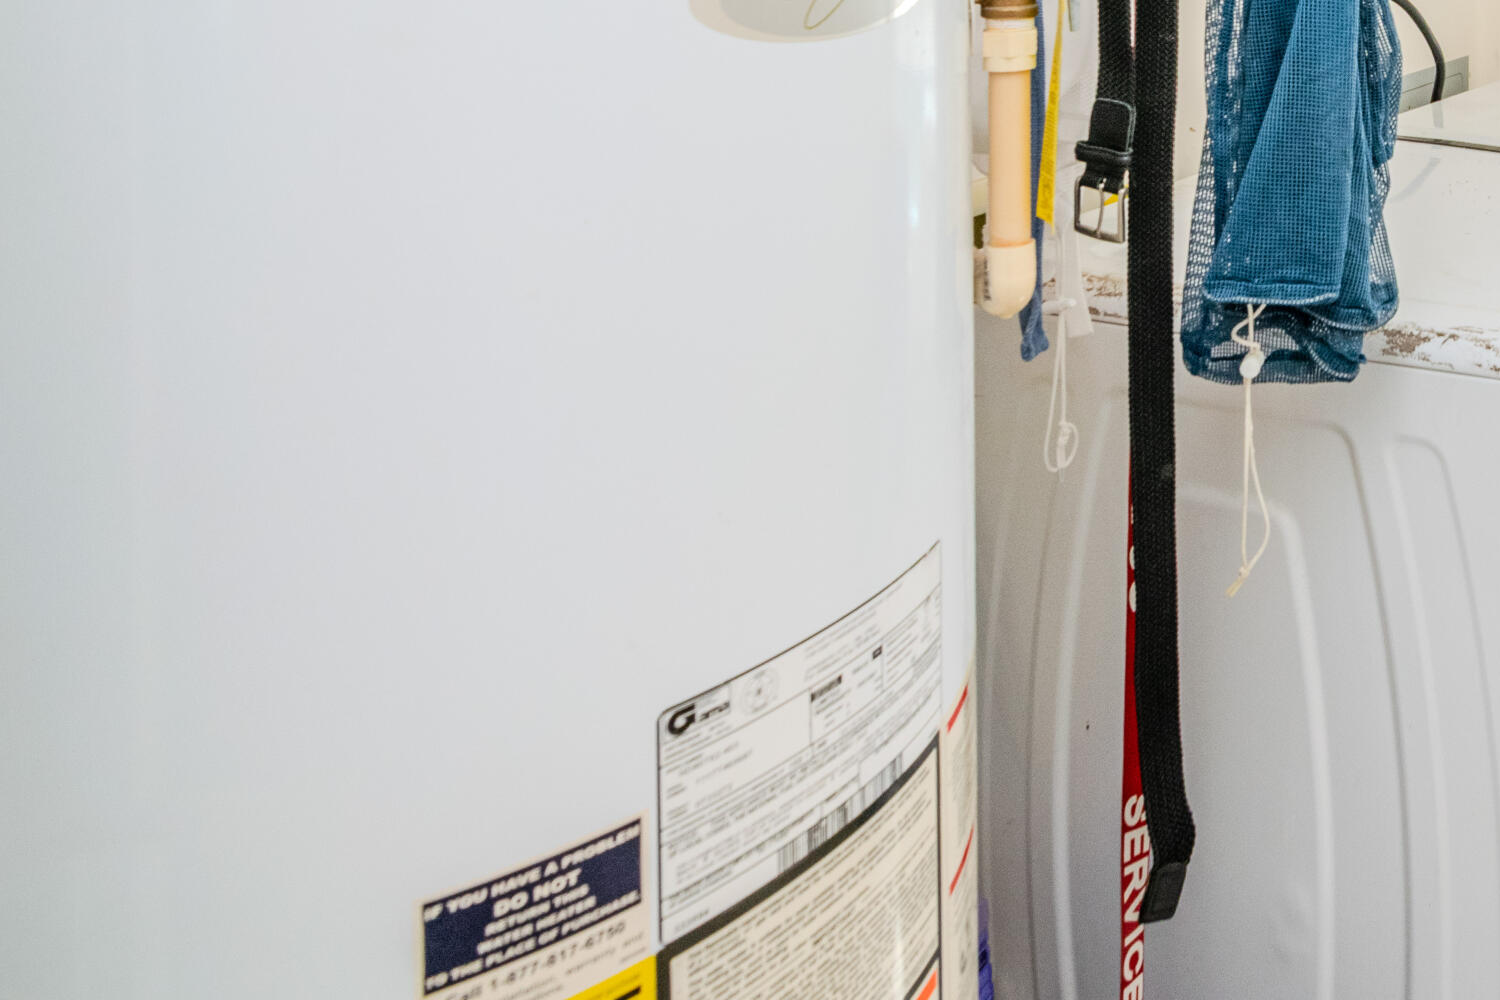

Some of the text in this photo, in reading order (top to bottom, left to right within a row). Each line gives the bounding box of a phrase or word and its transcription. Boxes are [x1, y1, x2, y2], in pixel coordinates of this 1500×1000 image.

[424, 824, 641, 922] IF YOU HAVE A PROBLEM
[493, 867, 582, 918] DO NOT
[476, 896, 597, 955] WATER HEATER
[484, 883, 590, 937] RETURN THIS
[426, 971, 448, 990] TO
[449, 958, 484, 981] THE
[485, 937, 537, 969] PLACE
[538, 927, 560, 946] OF
